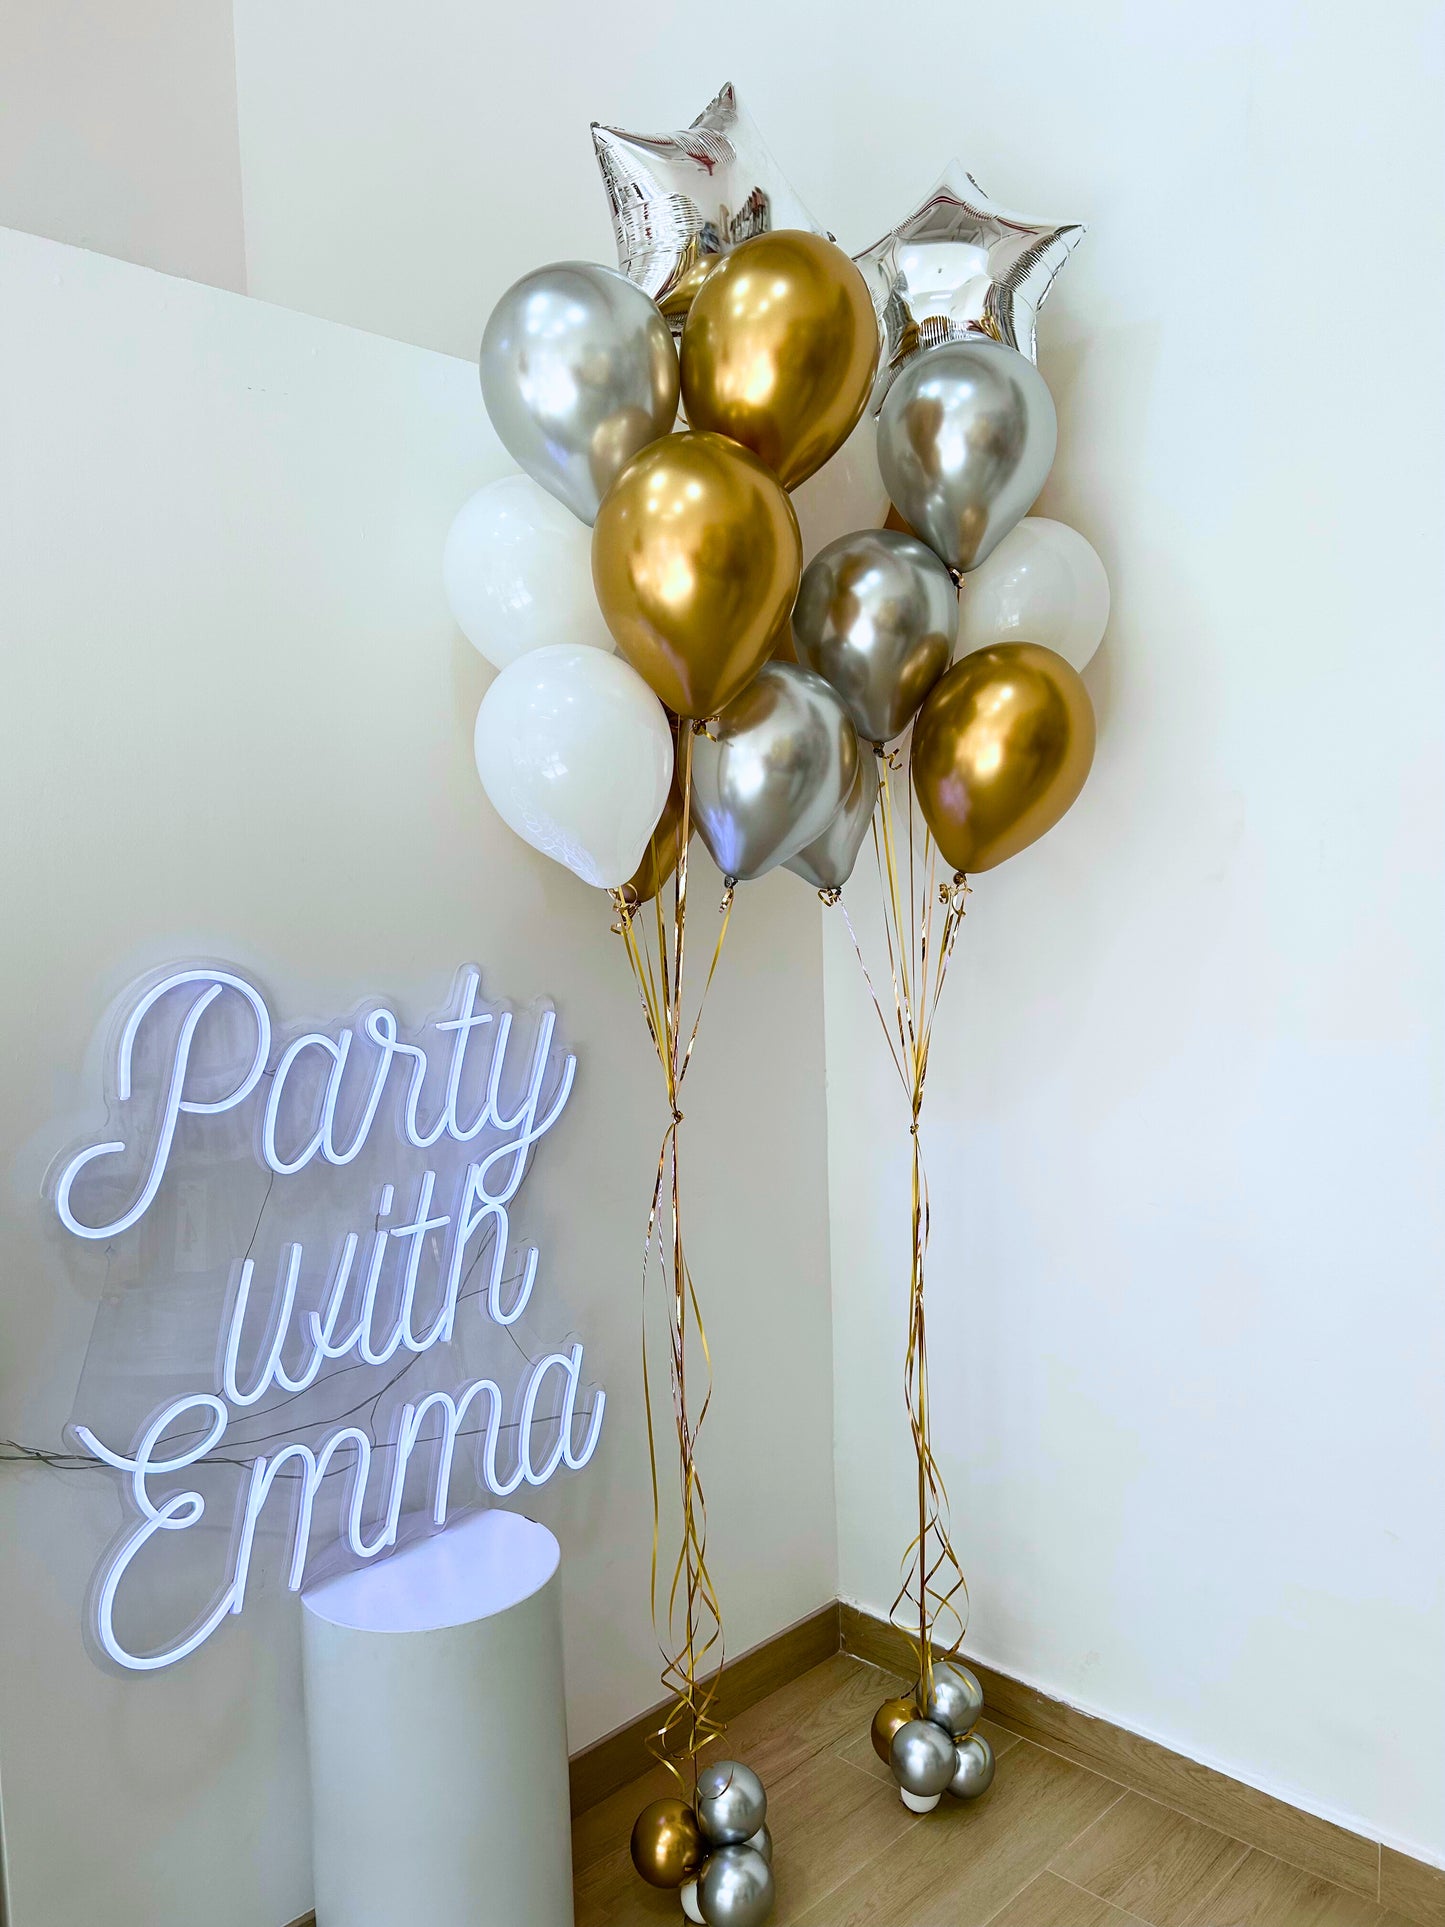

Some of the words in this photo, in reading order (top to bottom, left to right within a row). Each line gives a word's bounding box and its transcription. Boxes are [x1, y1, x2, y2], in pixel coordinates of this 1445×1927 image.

[57, 968, 577, 1239] Party
[223, 1162, 538, 1405] with
[75, 1343, 606, 1669] Emma
